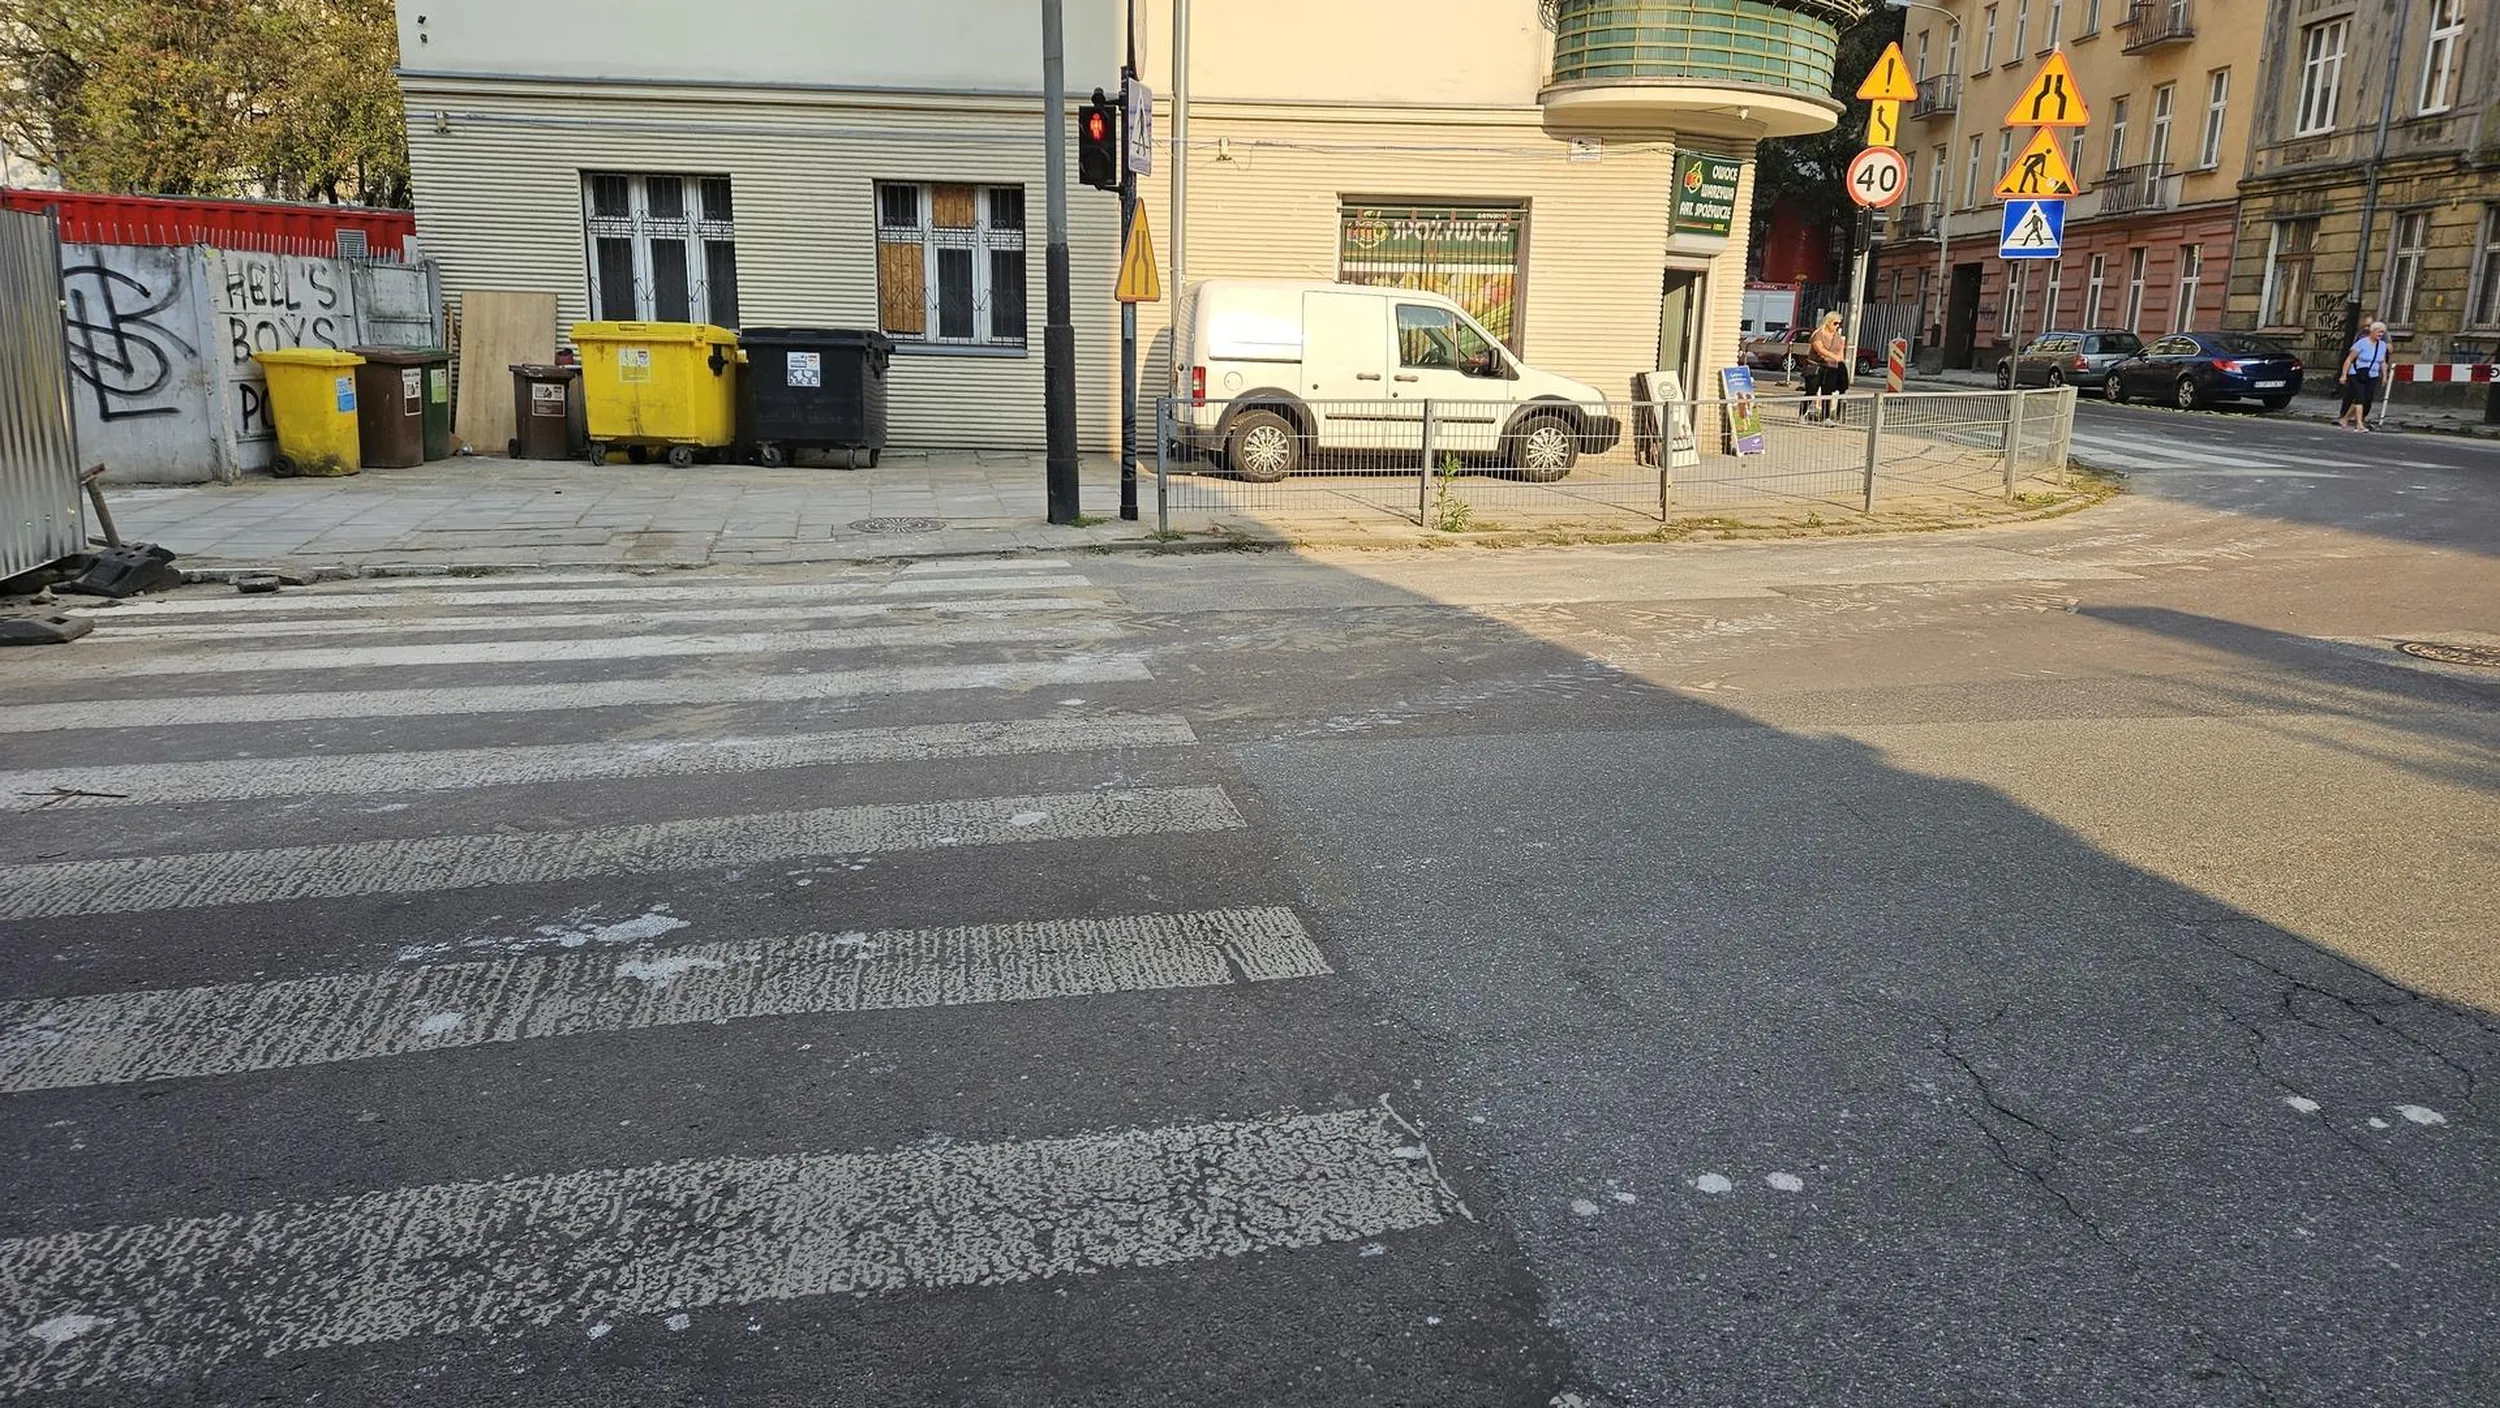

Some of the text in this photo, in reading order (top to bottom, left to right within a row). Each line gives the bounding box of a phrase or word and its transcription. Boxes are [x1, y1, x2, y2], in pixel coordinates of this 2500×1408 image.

[1713, 165, 1738, 181] OWOCE
[1856, 164, 1897, 192] 40
[229, 316, 338, 365] BOYS
